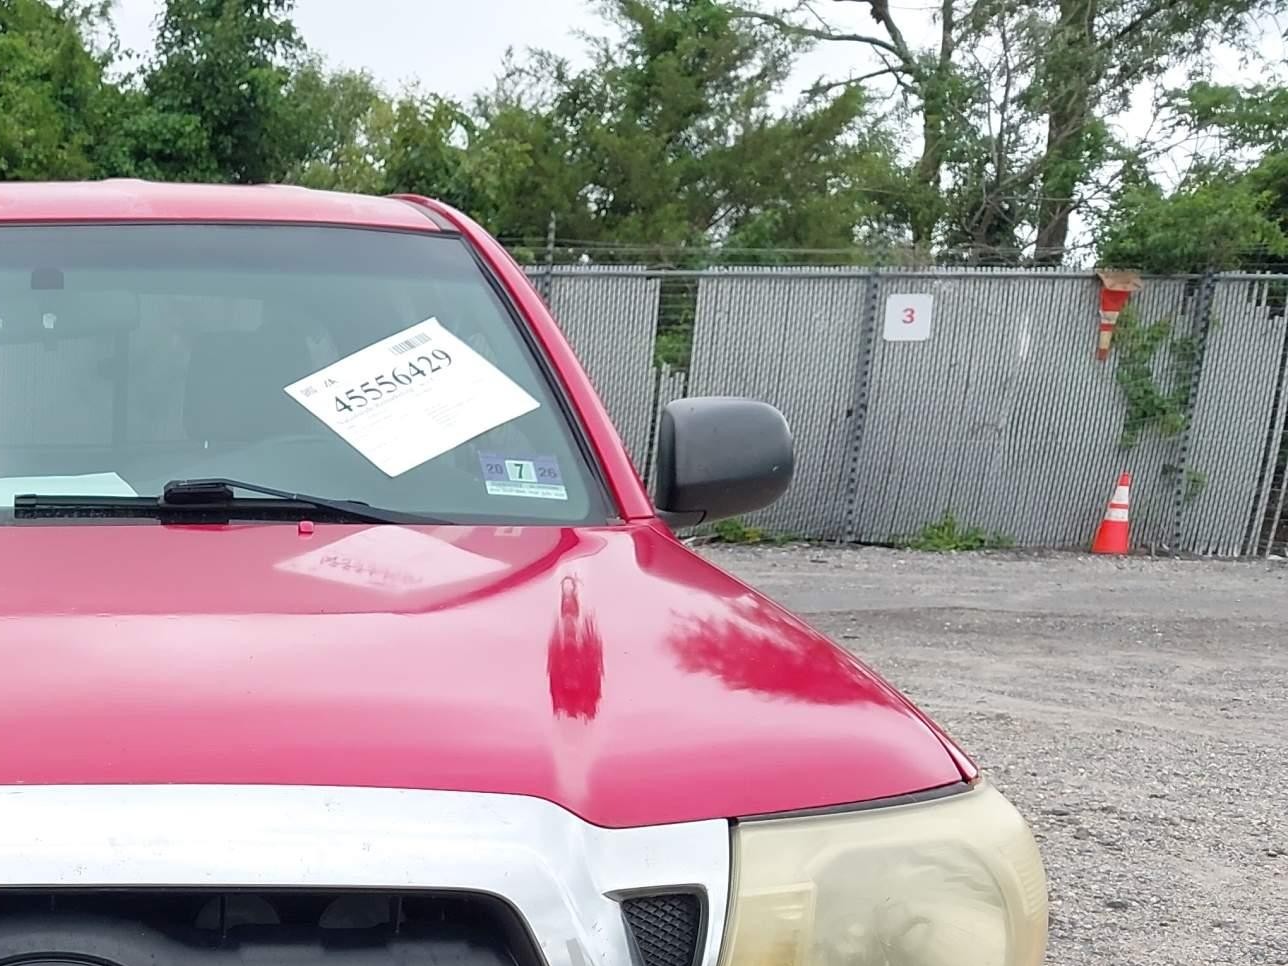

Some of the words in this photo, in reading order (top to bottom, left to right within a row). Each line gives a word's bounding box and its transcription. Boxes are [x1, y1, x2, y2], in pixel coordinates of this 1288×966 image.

[902, 308, 915, 325] 3
[334, 348, 452, 413] 45556429
[486, 463, 504, 475] 20
[514, 463, 524, 480] 7
[537, 467, 558, 479] 26
